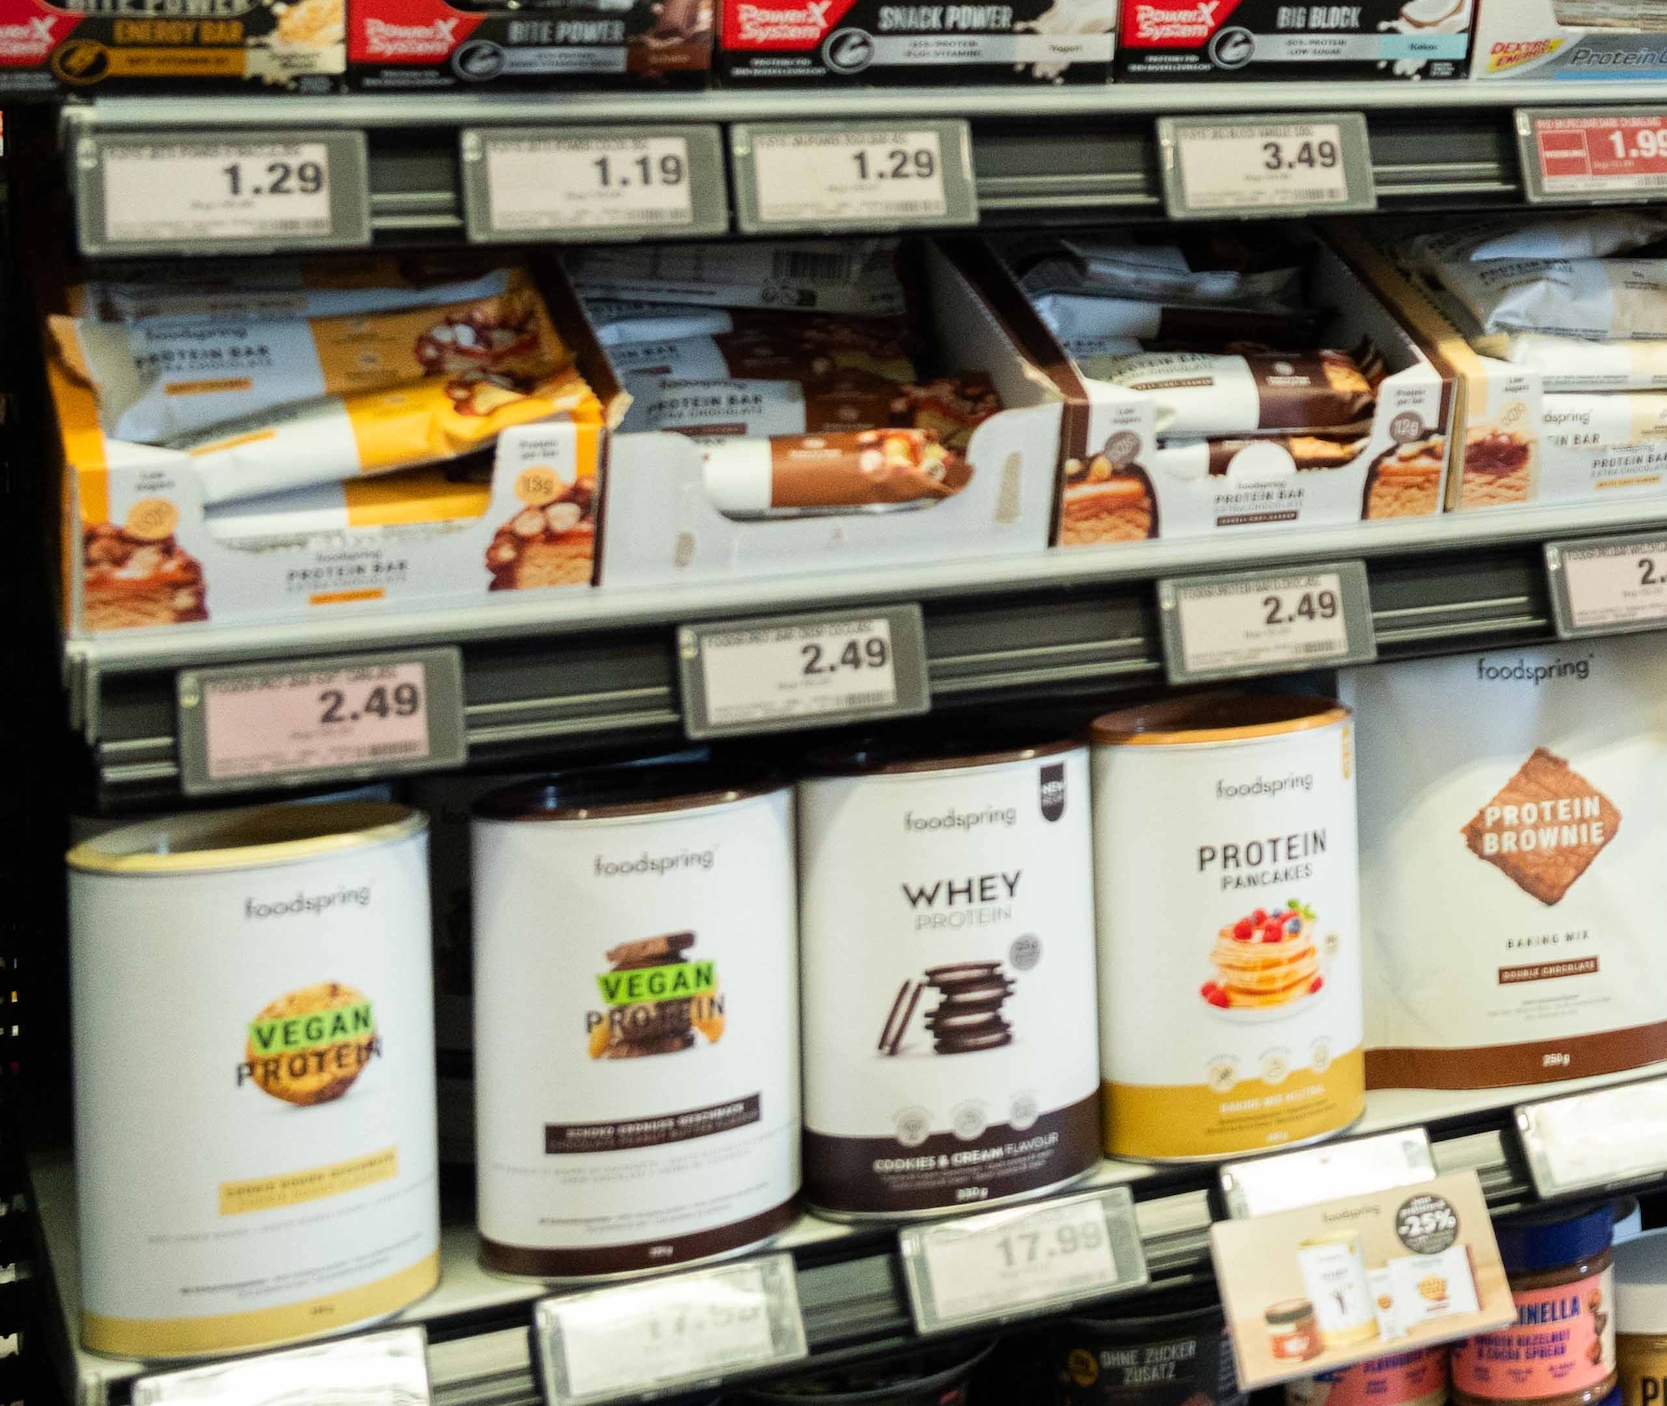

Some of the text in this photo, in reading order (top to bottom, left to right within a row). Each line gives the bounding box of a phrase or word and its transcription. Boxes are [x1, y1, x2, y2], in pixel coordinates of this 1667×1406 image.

[879, 6, 1011, 30] SNACK POWER
[1277, 7, 1360, 29] BIG BLOCK
[592, 155, 682, 186] 1.19
[1262, 141, 1338, 172] 3.49
[222, 163, 322, 196] 1.29
[1477, 655, 1589, 684] foodspring
[319, 685, 419, 725] 2.49
[904, 806, 1017, 833] foodspring
[1484, 796, 1602, 828] PROTEIN
[1198, 828, 1327, 871] PROTEIN
[1483, 821, 1605, 853] BROWNIE
[594, 848, 714, 877] foodspring
[1220, 864, 1312, 890] PANCAKES
[902, 871, 1021, 908] WHEY
[916, 904, 1012, 931] PROTEIN
[600, 964, 714, 1002] VEGAN
[253, 1006, 372, 1049] VEGAN
[586, 995, 725, 1035] PROTEIN
[238, 1038, 381, 1086] PROTEIN
[873, 1152, 938, 1173] COOKIES
[952, 1146, 1004, 1166] CREAM
[1006, 1133, 1059, 1153] FLAVOUR
